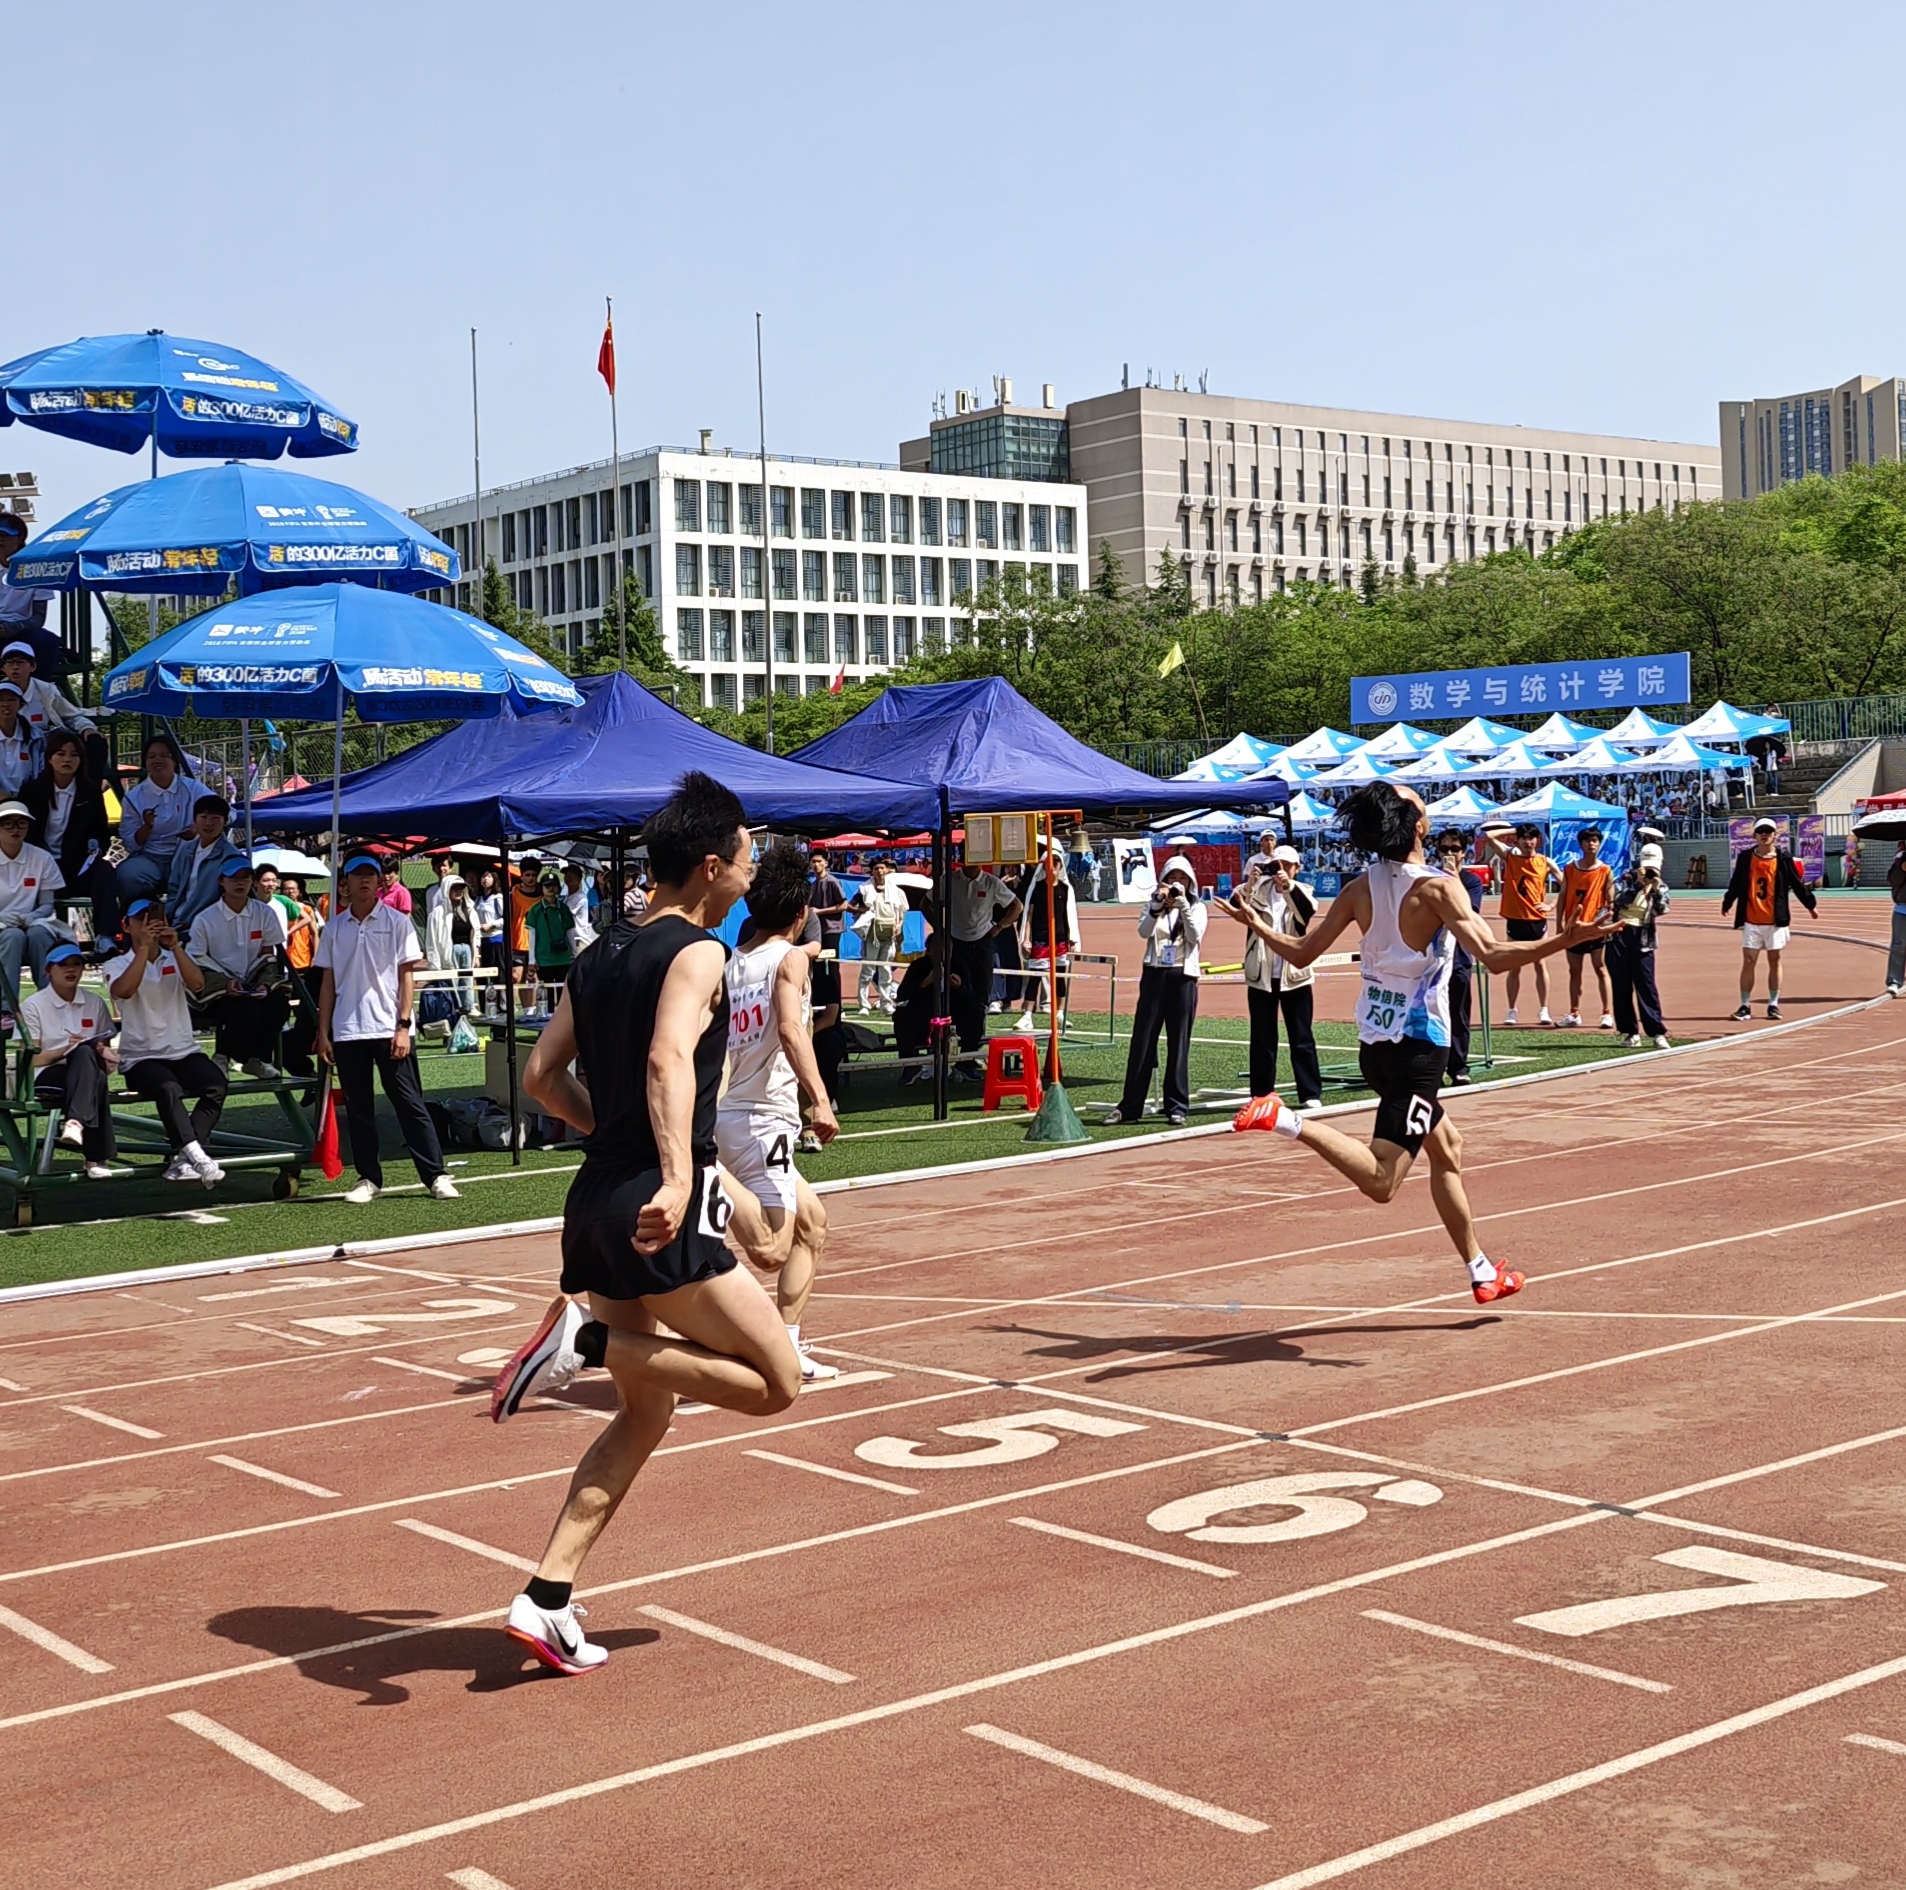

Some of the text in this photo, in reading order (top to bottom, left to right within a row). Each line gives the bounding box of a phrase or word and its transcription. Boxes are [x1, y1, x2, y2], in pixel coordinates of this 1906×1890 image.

[1409, 665, 1666, 711] 数学与统计学院
[1756, 877, 1768, 900] 3
[1367, 985, 1407, 1007] 物信院
[732, 1004, 764, 1036] 101
[1410, 1100, 1431, 1135] 5
[766, 1133, 790, 1174] 4
[707, 1174, 732, 1234] 6
[288, 1298, 519, 1336] 2
[853, 1409, 1150, 1470] 5
[1146, 1471, 1444, 1544] 6
[1512, 1545, 1889, 1637] 7
